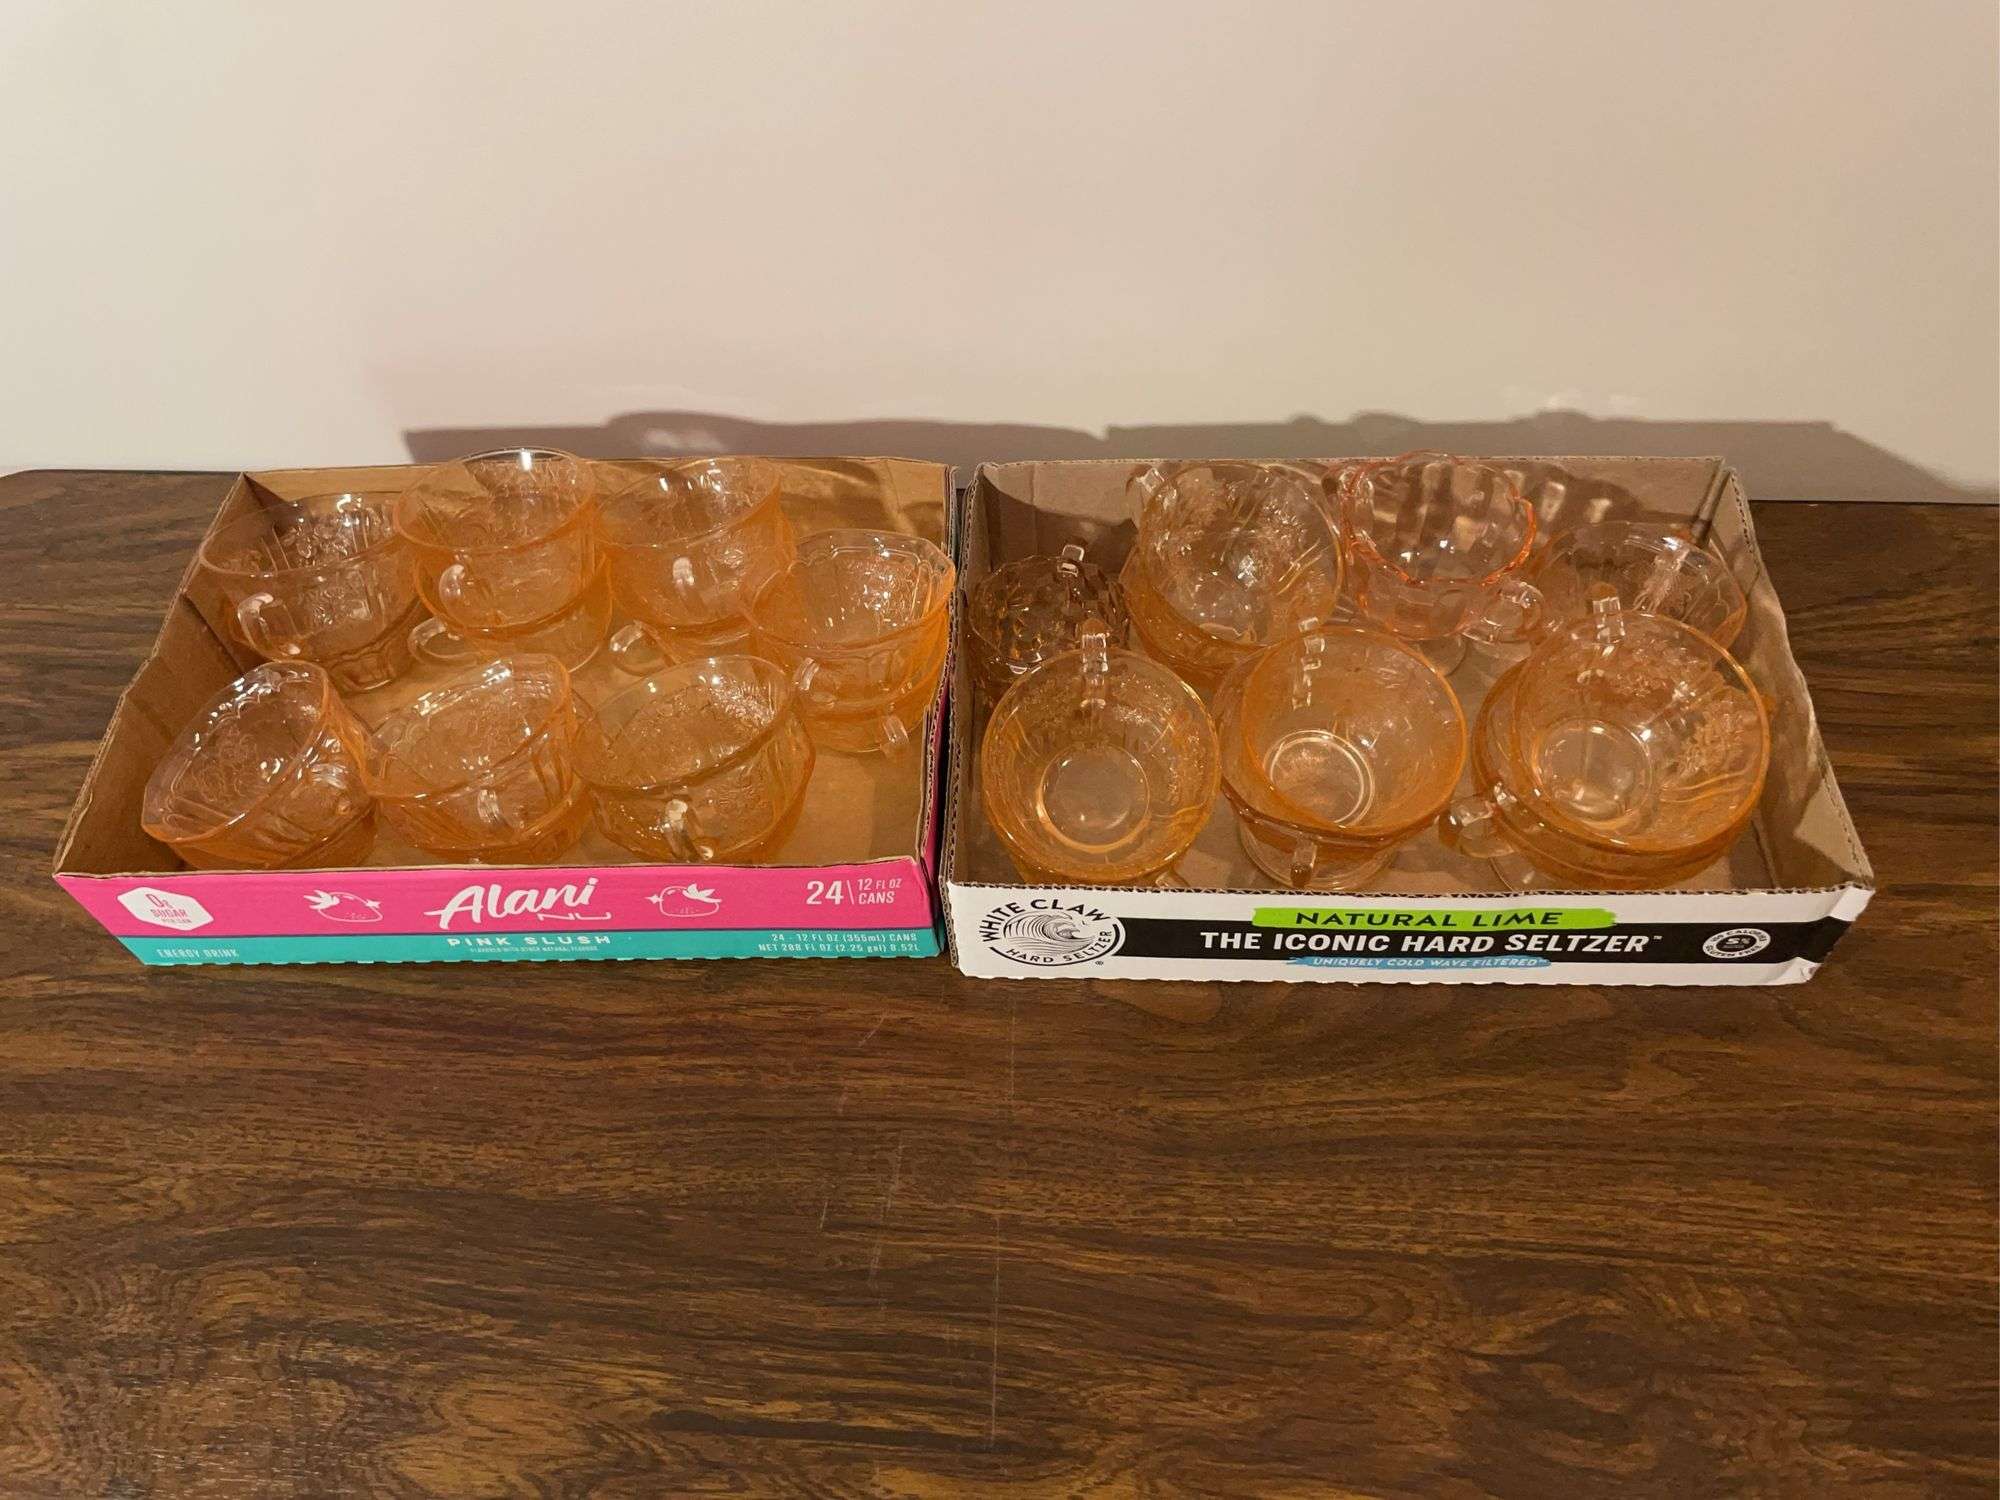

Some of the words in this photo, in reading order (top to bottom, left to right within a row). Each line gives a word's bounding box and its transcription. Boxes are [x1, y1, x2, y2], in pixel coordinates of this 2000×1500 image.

[857, 878, 872, 891] 12
[876, 879, 886, 890] FL
[889, 878, 902, 889] OZ
[806, 880, 844, 905] 24
[859, 891, 896, 905] CANS
[423, 877, 599, 930] Alani
[150, 907, 189, 919] SUGAR
[1296, 912, 1457, 926] NATURAL
[1472, 912, 1563, 927] LIME
[979, 902, 1025, 942] WHITE
[1030, 899, 1111, 922] CLAW
[446, 937, 511, 947] PINK
[523, 935, 611, 945] SLUSH
[889, 933, 917, 942] CANS
[1200, 932, 1262, 950] THE
[1273, 933, 1391, 951] ICONIC
[1401, 935, 1494, 952] HARD
[156, 948, 200, 958] ENERGY
[202, 948, 240, 958] DRINK
[758, 944, 778, 952] NET
[1006, 948, 1054, 963] HARD
[1063, 931, 1113, 962] SELTZER
[1313, 958, 1385, 967] UNIQUELY
[1387, 958, 1424, 967] COLD
[1430, 958, 1468, 967] WAVE
